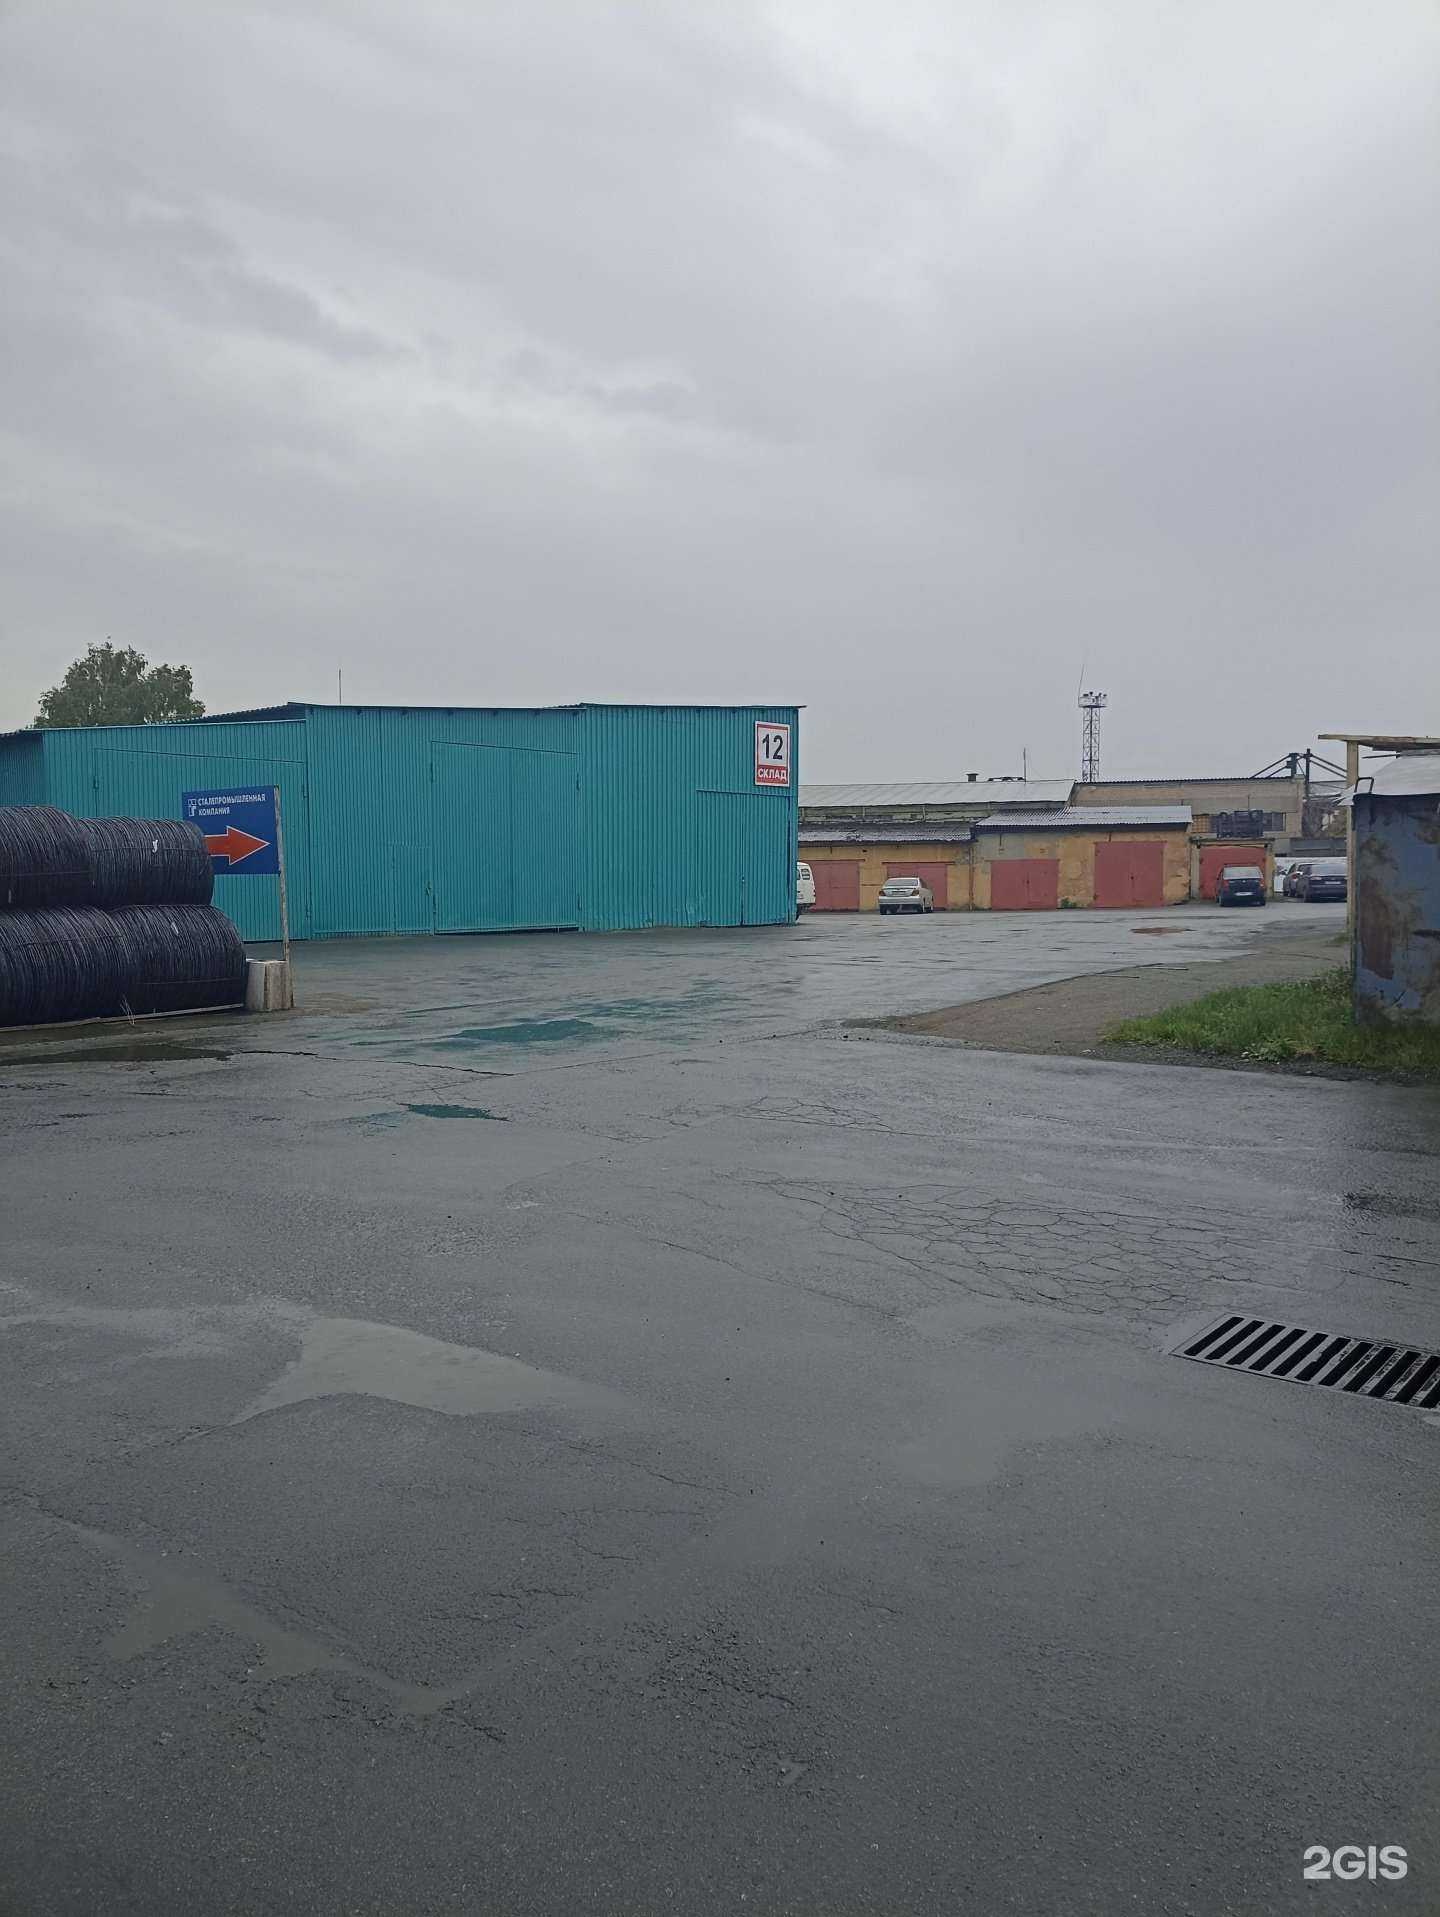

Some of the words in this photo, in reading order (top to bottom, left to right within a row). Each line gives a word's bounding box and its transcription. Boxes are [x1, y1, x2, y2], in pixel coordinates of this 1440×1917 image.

[762, 733, 784, 760] 12
[758, 768, 787, 781] СКЛАД
[198, 806, 231, 816] КОМПАНИЯ
